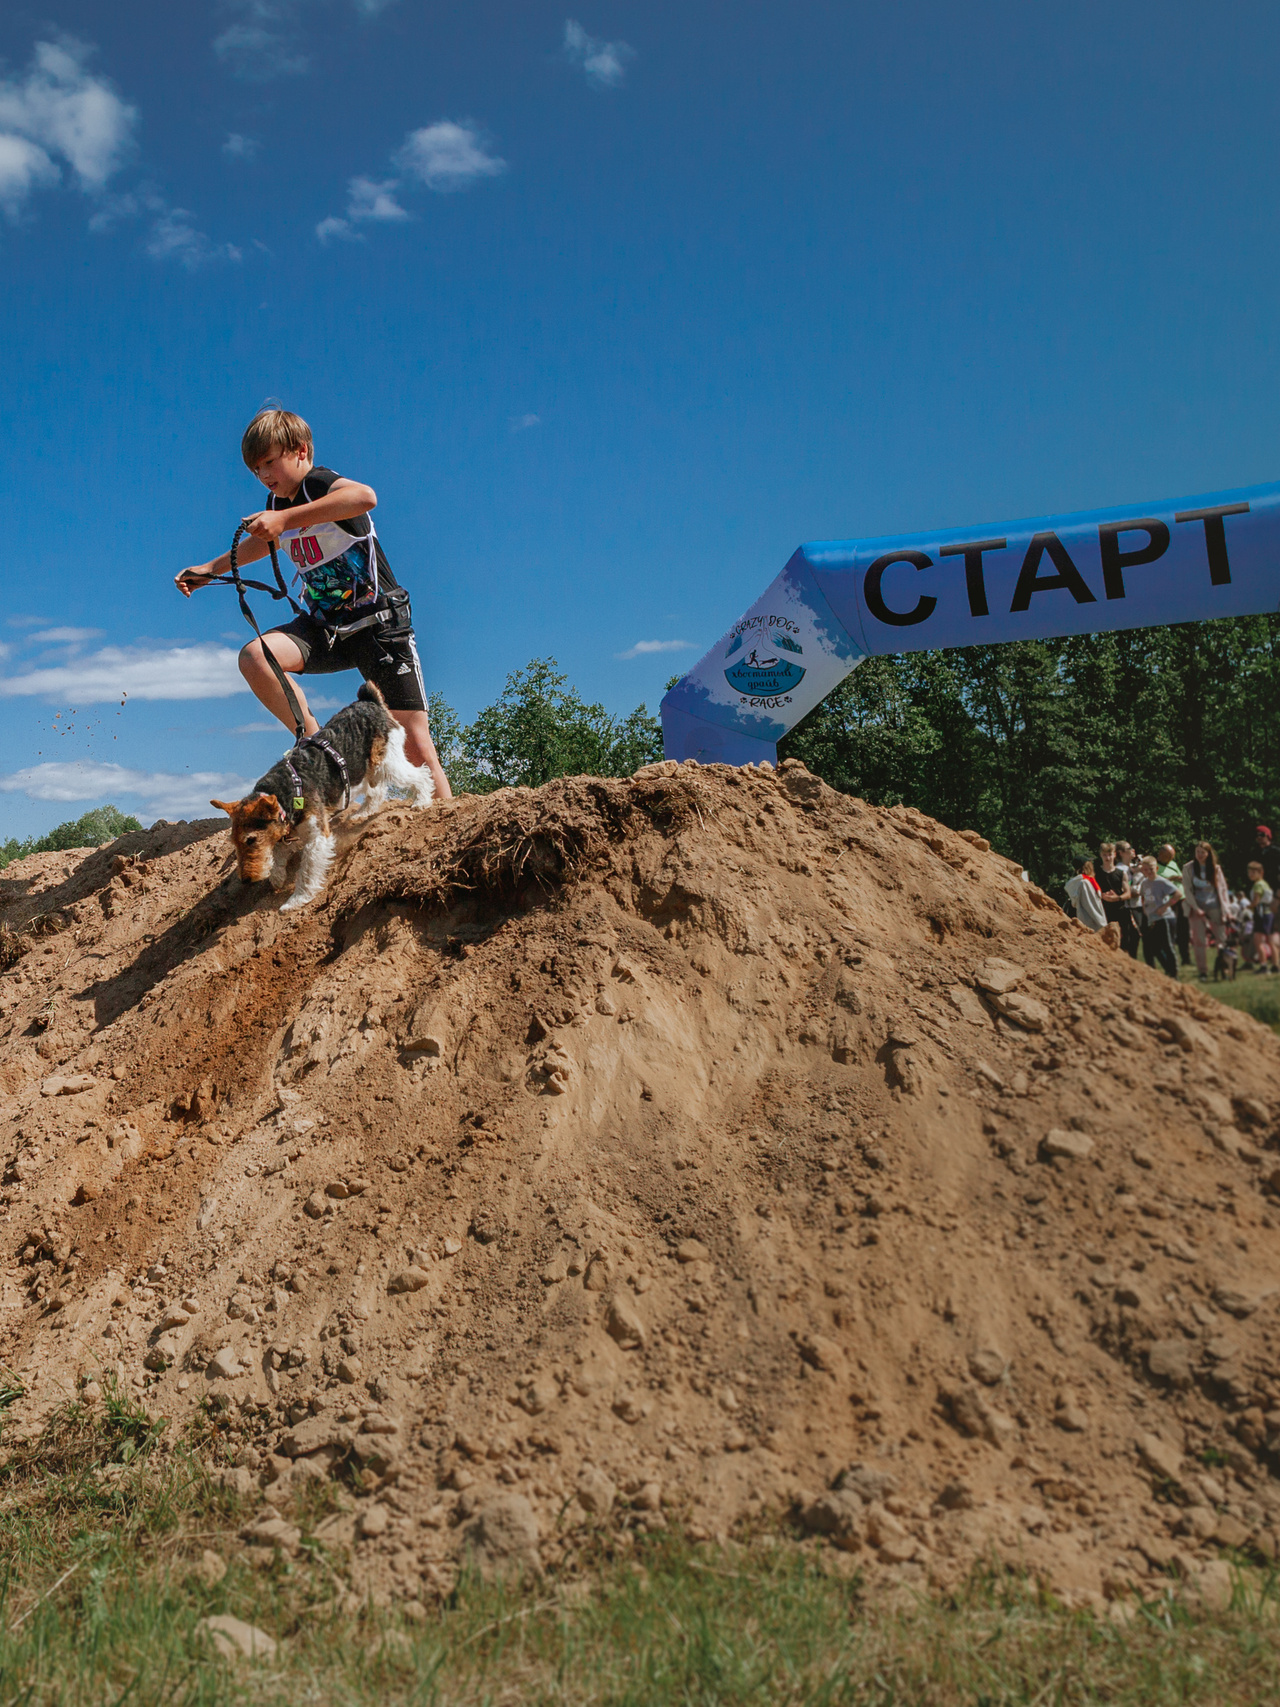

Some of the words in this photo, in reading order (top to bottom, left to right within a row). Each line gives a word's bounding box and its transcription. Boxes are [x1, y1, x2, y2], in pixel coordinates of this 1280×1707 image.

[290, 535, 324, 568] 40
[864, 502, 1250, 626] СТАРТ
[735, 615, 763, 635] CRAZY
[769, 615, 795, 632] DOG
[747, 678, 780, 692] драйв
[749, 697, 785, 710] RACE
